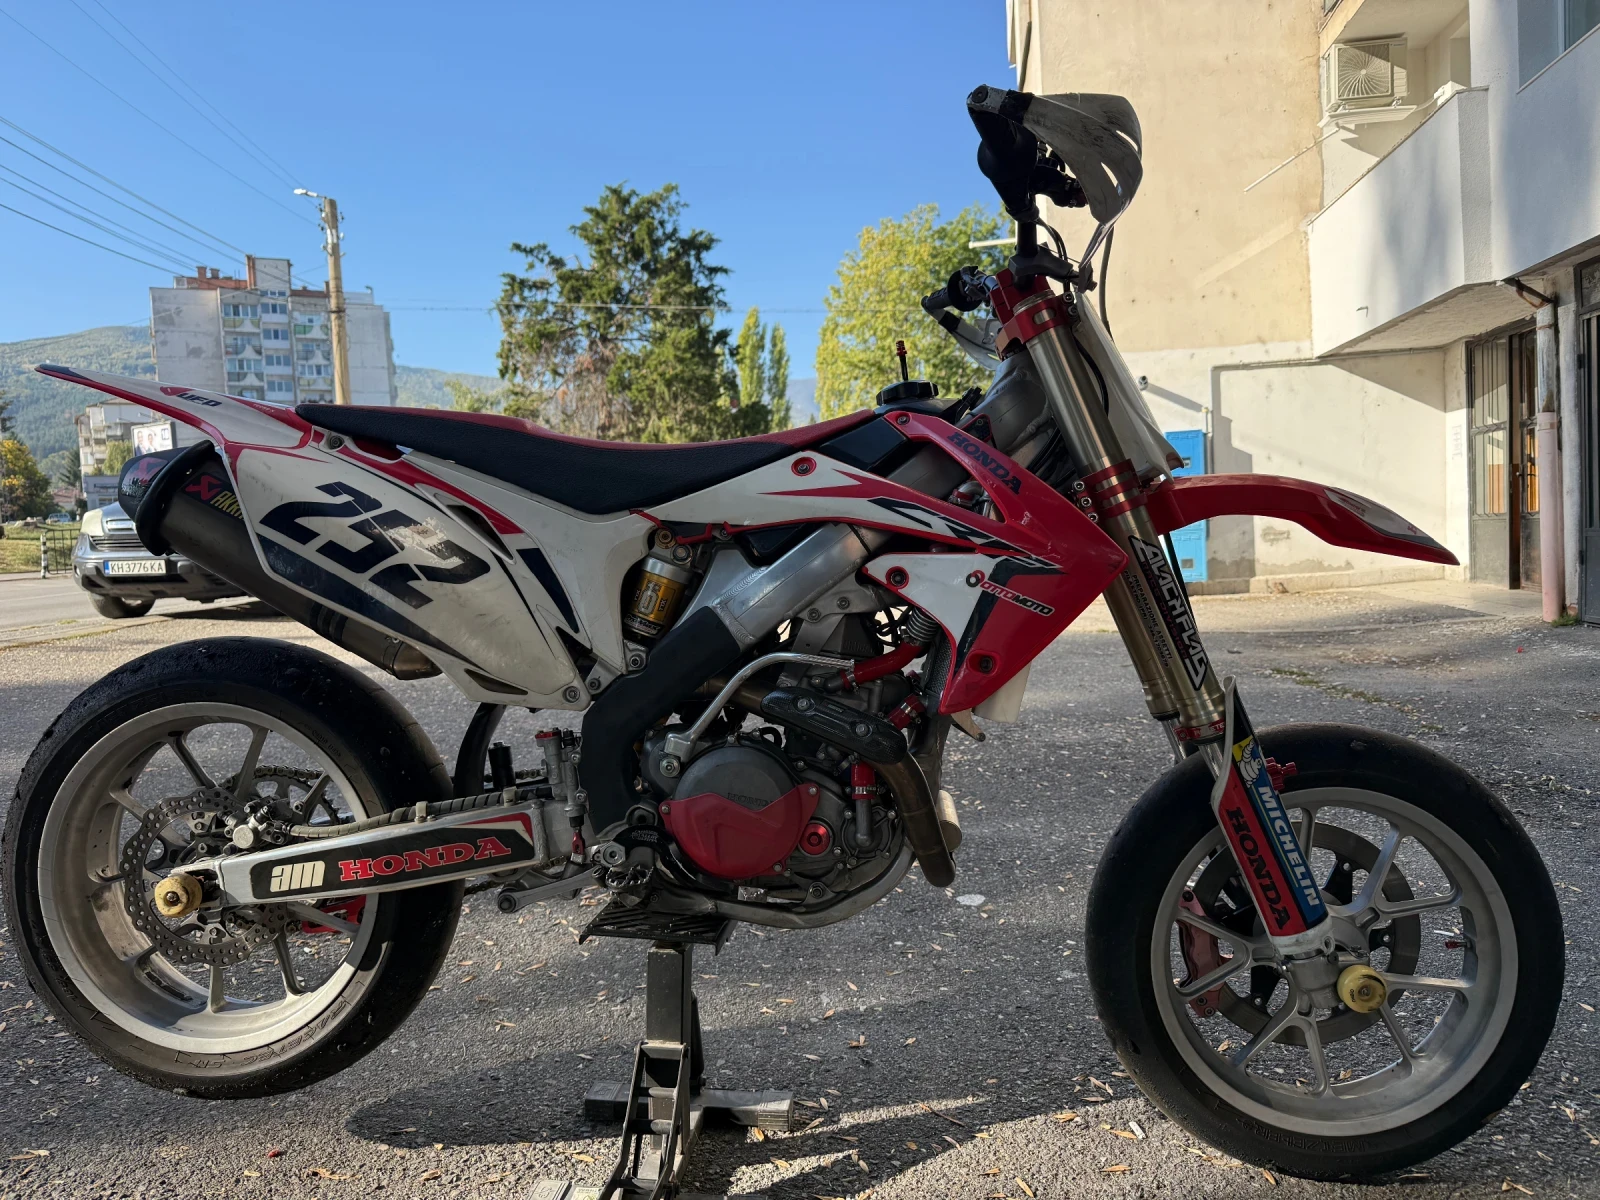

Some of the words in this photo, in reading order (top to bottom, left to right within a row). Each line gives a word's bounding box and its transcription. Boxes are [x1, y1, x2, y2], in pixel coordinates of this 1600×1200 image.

[946, 431, 1023, 496] HONDA
[980, 580, 1054, 616] OTTOMOTO
[1132, 574, 1160, 630] PREPARAZIONE
[339, 836, 512, 882] HONDA
[1226, 806, 1291, 931] HONDA
[1257, 786, 1320, 907] MICHELIN
